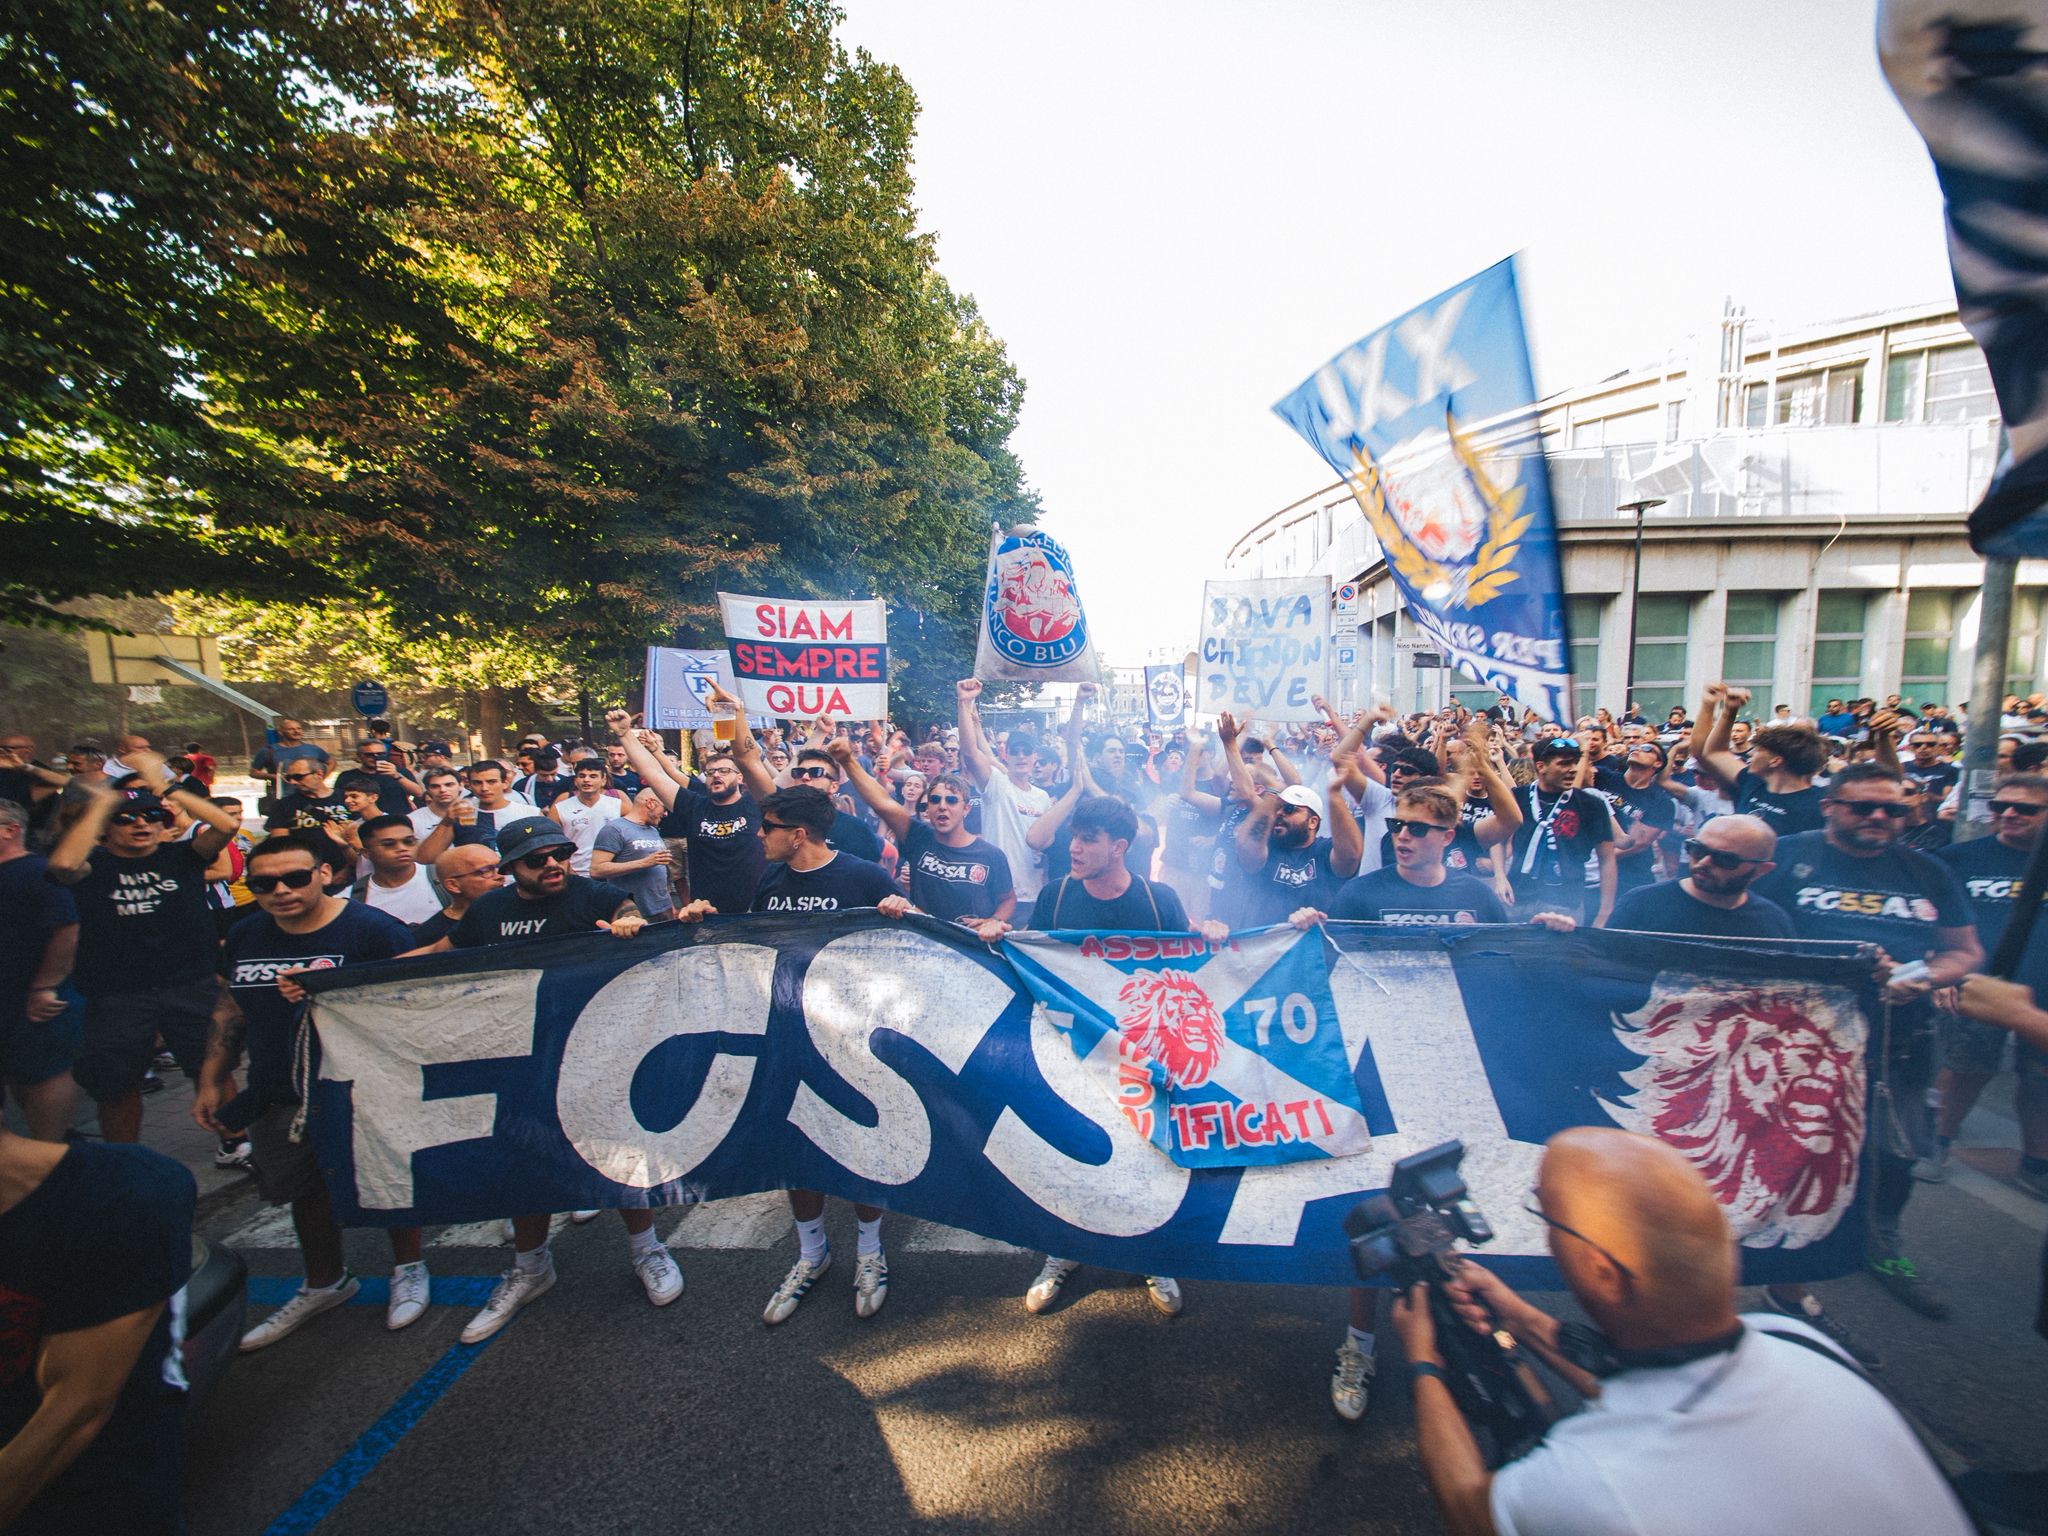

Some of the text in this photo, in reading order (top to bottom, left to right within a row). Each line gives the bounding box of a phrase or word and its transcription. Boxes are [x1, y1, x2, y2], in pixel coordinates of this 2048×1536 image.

[755, 604, 853, 641] SIAM
[735, 643, 880, 679] SEMPRE
[1034, 637, 1077, 661] BLU
[766, 685, 852, 714] QUA
[1207, 674, 1309, 707] BEVE
[501, 918, 547, 937] WHY
[1243, 993, 1318, 1046] 70
